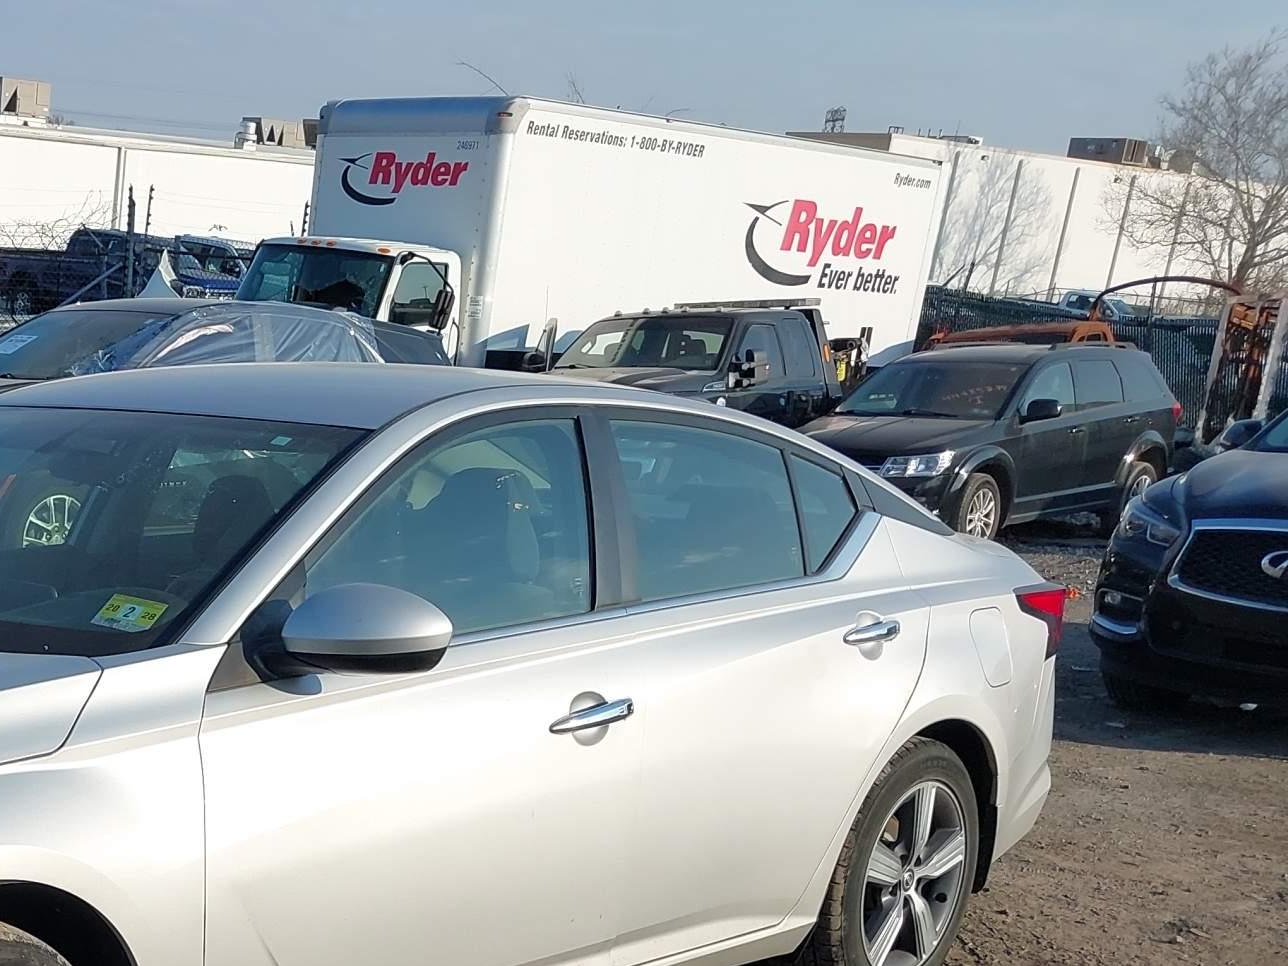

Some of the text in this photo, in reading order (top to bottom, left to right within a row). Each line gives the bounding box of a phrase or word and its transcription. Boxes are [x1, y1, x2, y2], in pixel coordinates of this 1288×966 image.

[526, 120, 705, 158] Rental Reservations: 1-800-BY-RYDER
[368, 151, 469, 194] Ryder
[893, 172, 932, 189] Ryder.com
[779, 198, 898, 268] Ryder
[817, 262, 900, 294] Ever better.
[122, 606, 137, 618] 2
